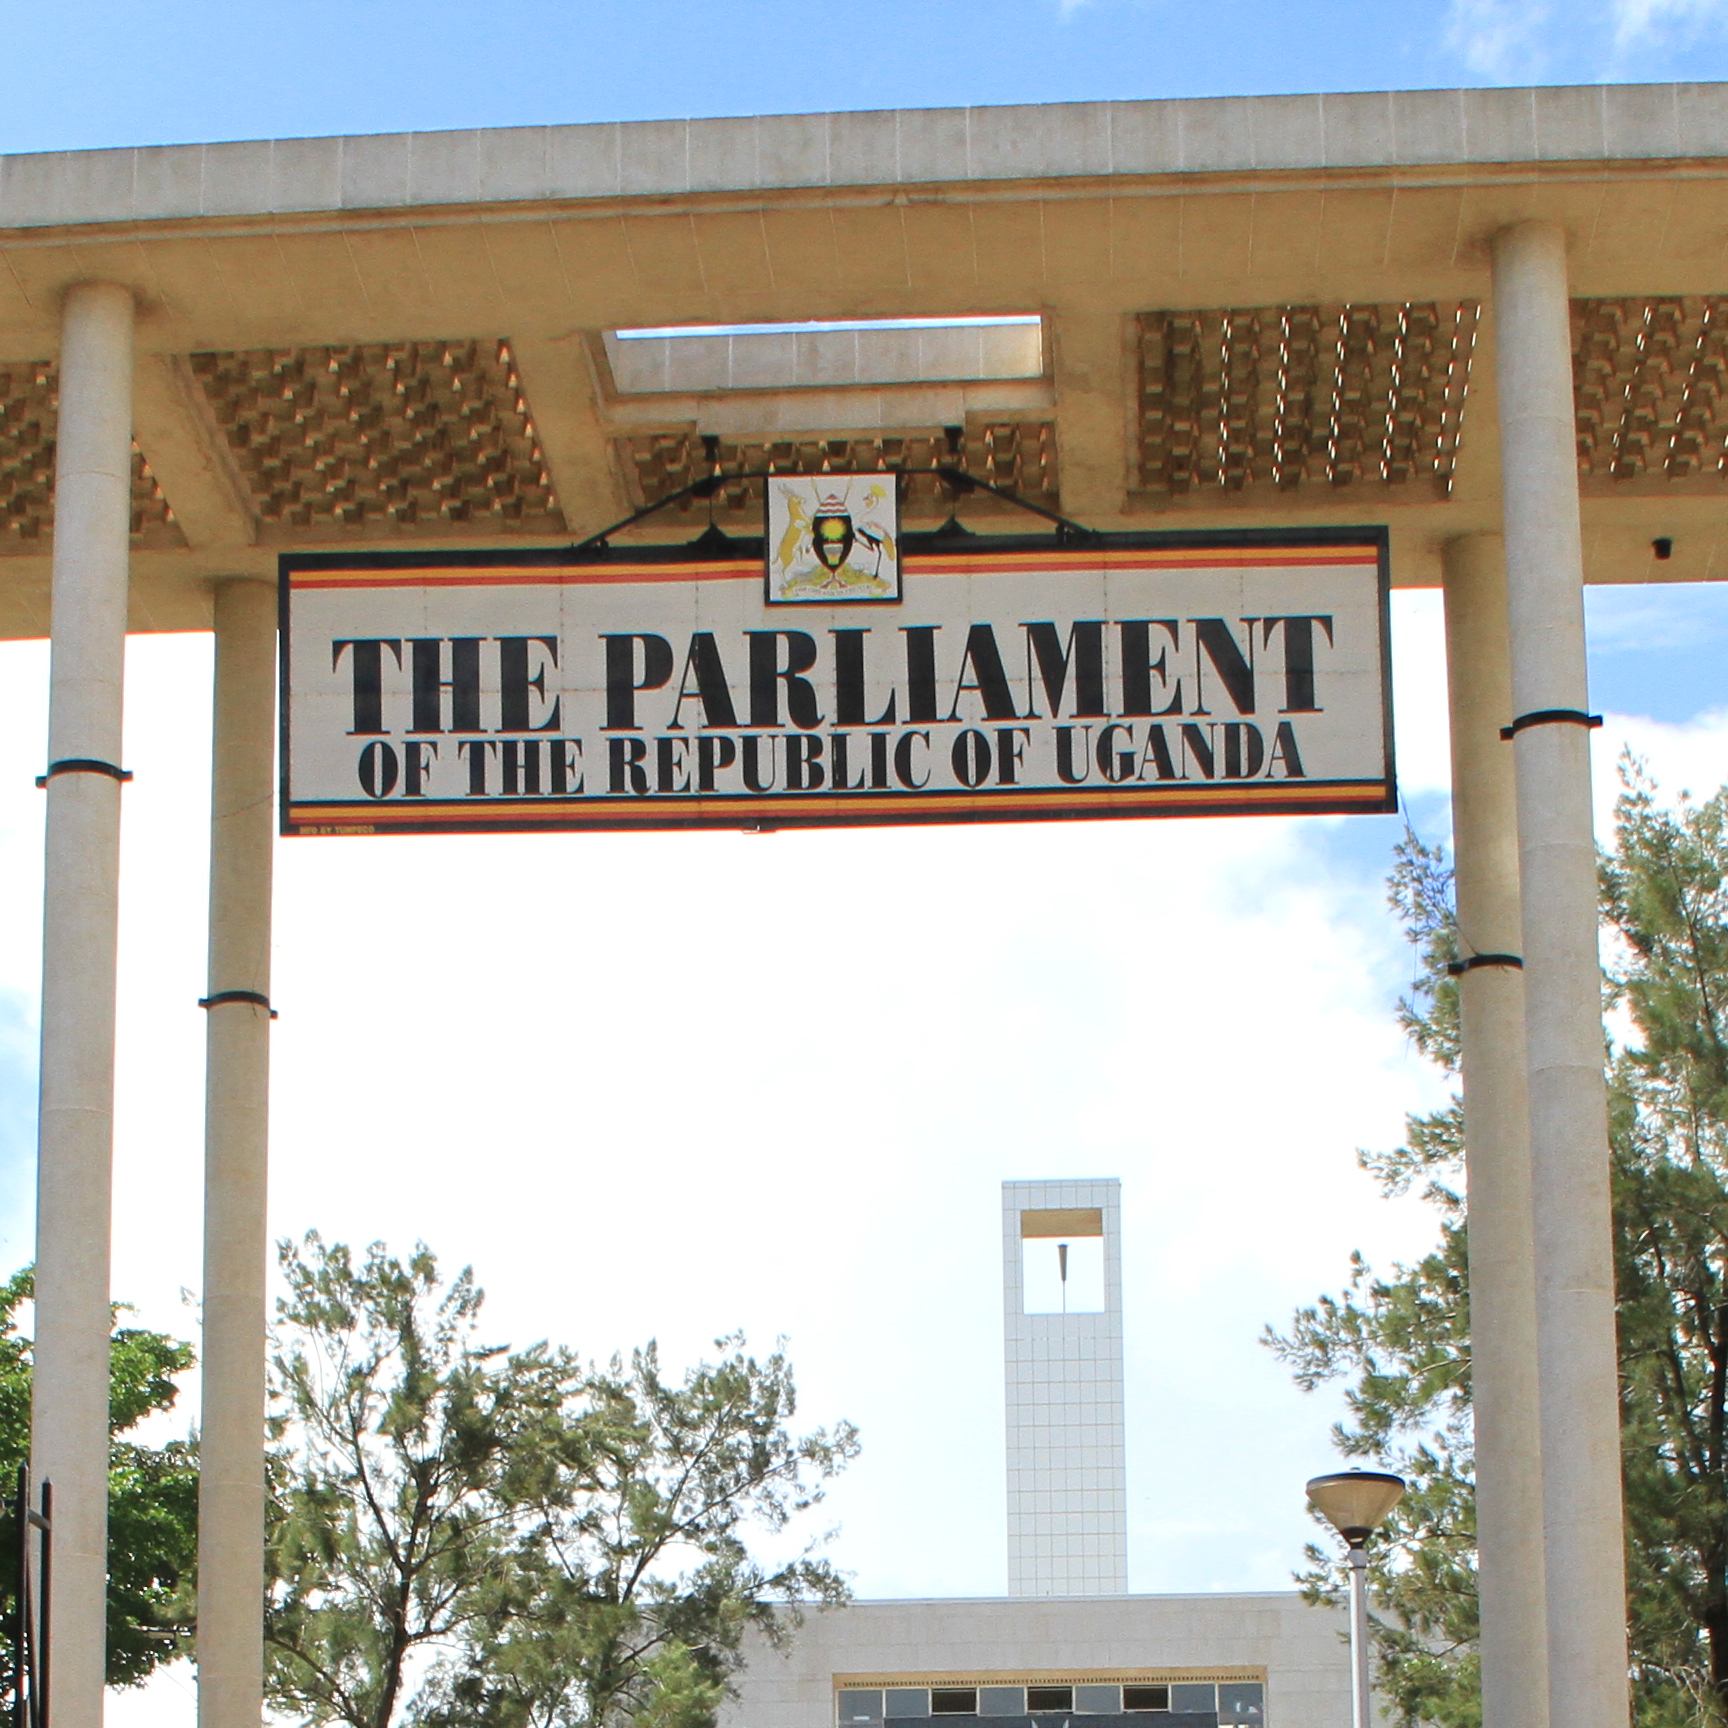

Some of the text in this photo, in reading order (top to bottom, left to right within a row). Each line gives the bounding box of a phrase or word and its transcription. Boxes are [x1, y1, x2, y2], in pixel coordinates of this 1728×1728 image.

[332, 615, 1334, 736] THE PARLIAMENT
[358, 721, 1307, 799] OF THE REPUBLIC OF UGANDA
